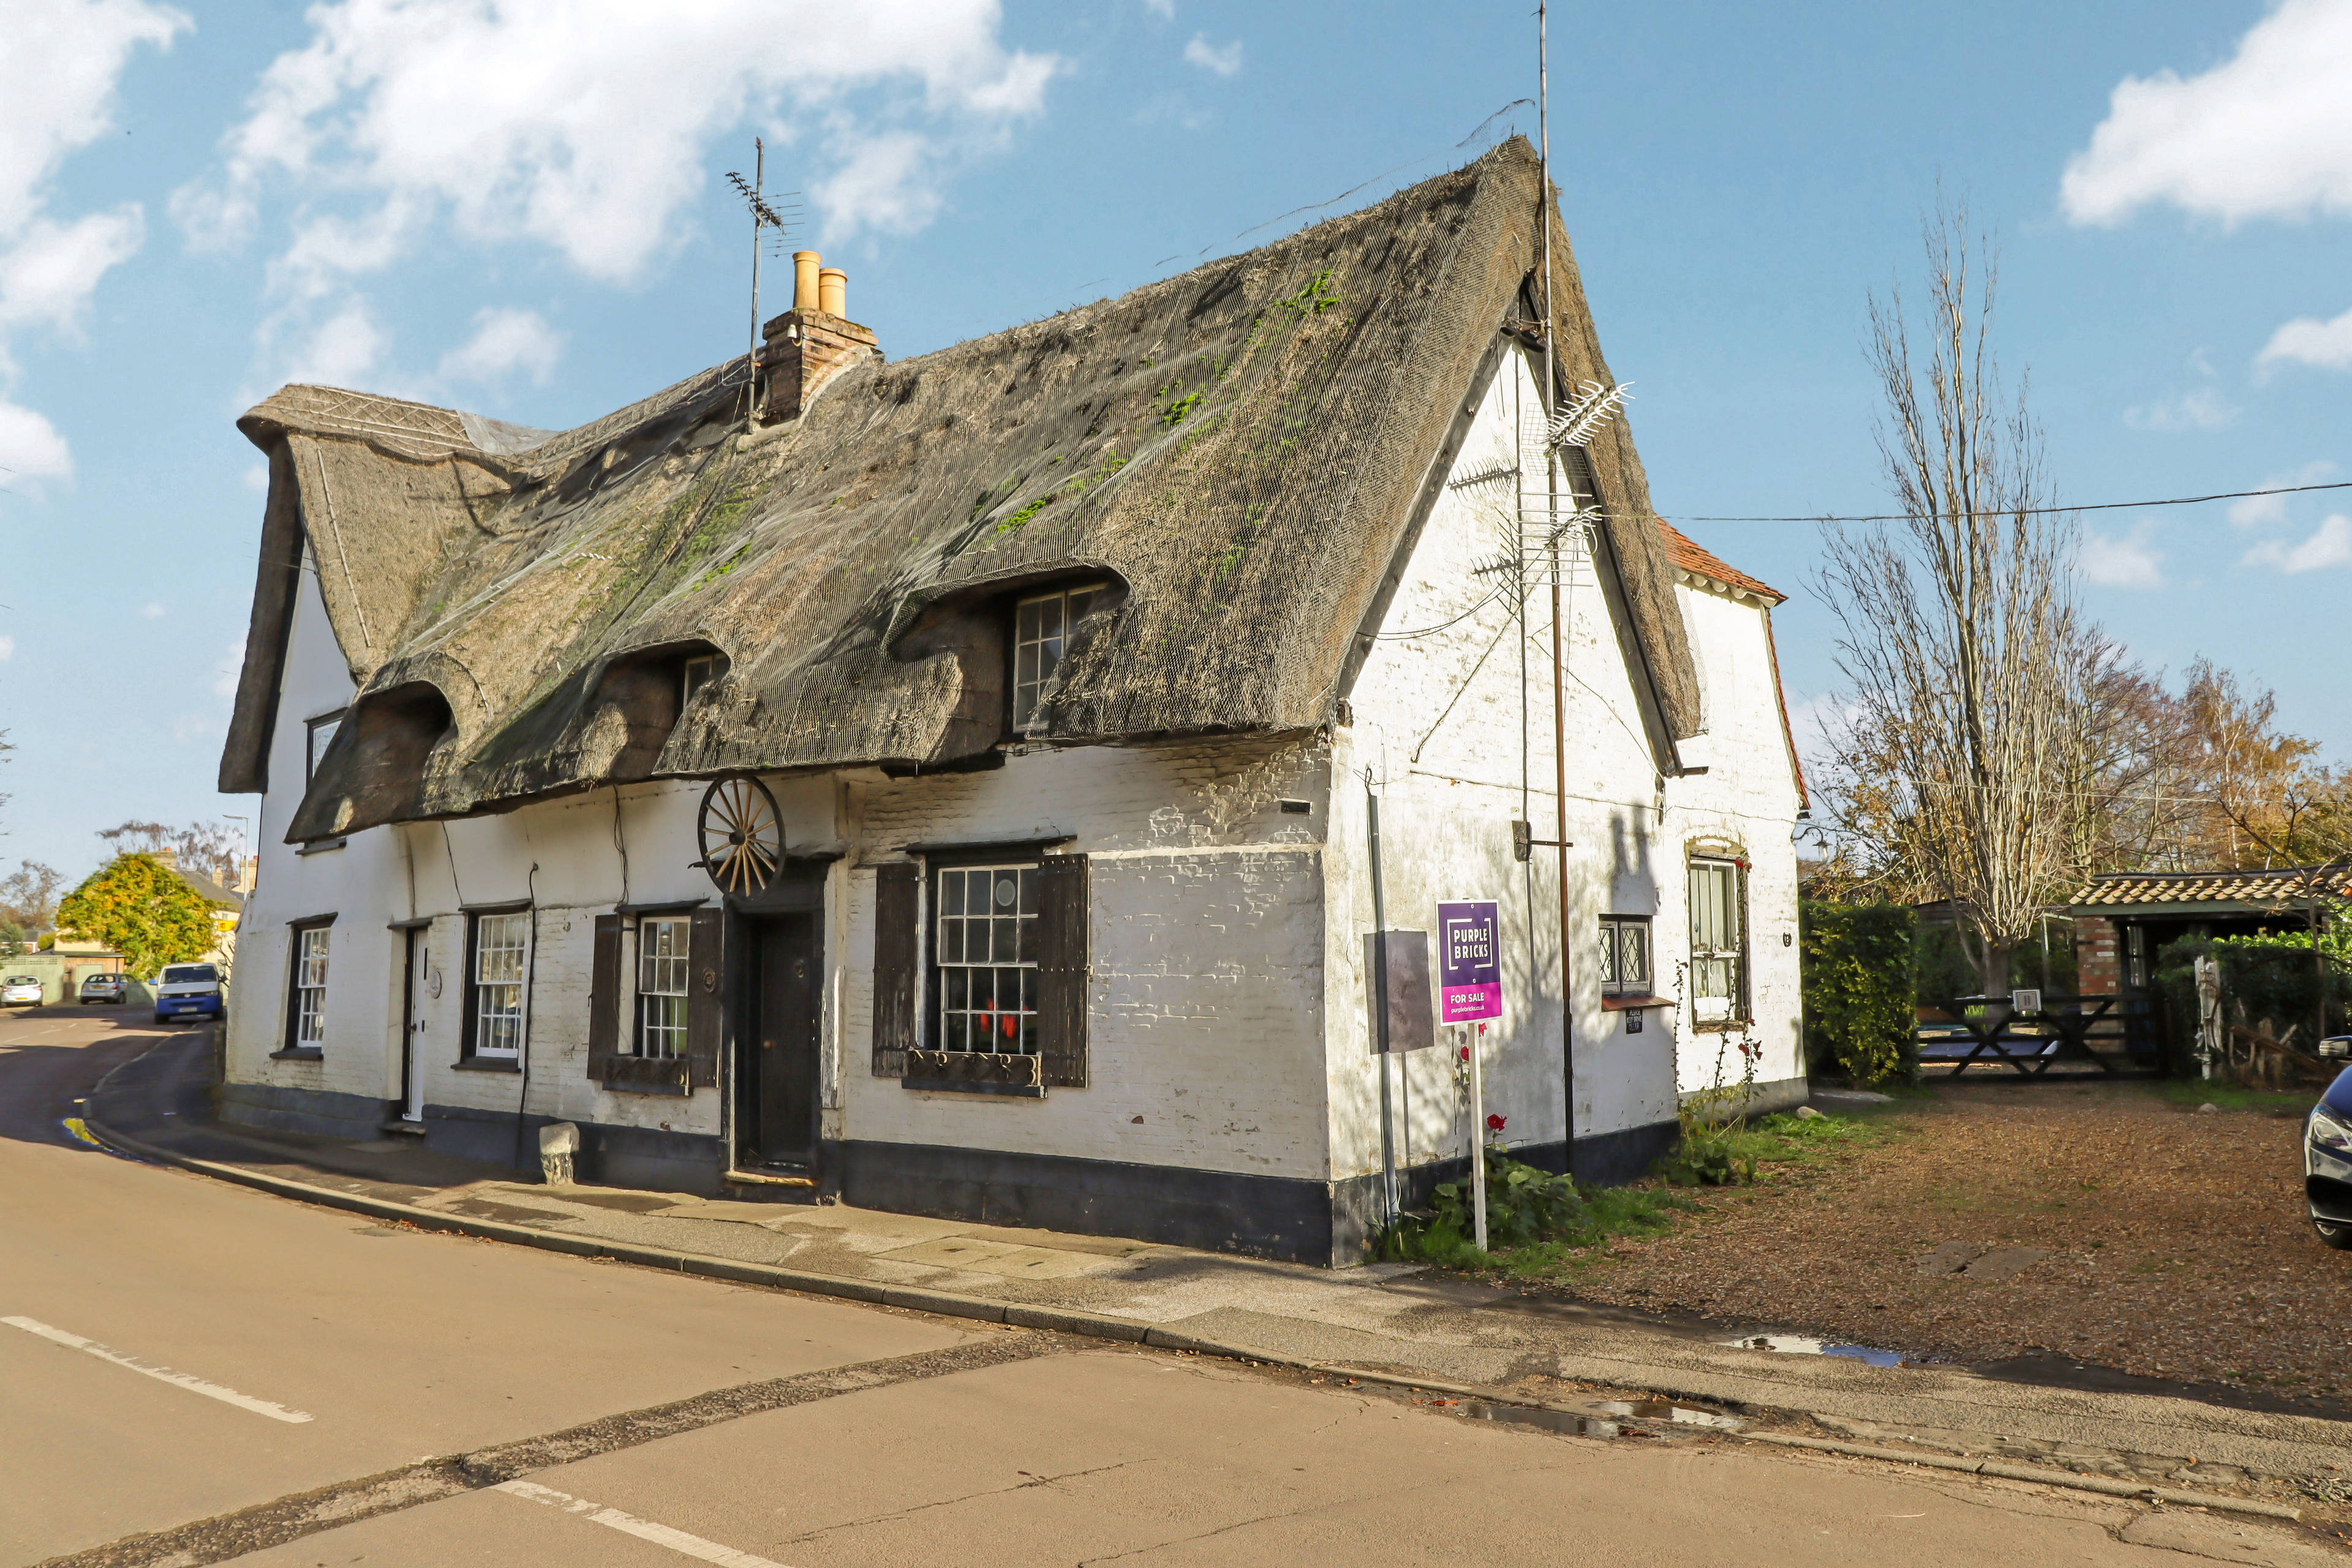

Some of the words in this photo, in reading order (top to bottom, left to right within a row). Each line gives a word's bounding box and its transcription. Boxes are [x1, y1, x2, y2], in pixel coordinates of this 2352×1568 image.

[1454, 929, 1488, 943] PURPLE
[1455, 944, 1488, 959] BRICKS
[1450, 994, 1466, 1004] FOR
[1468, 992, 1485, 1003] SALE
[1451, 1005, 1485, 1014] purplebricks.co.uk
